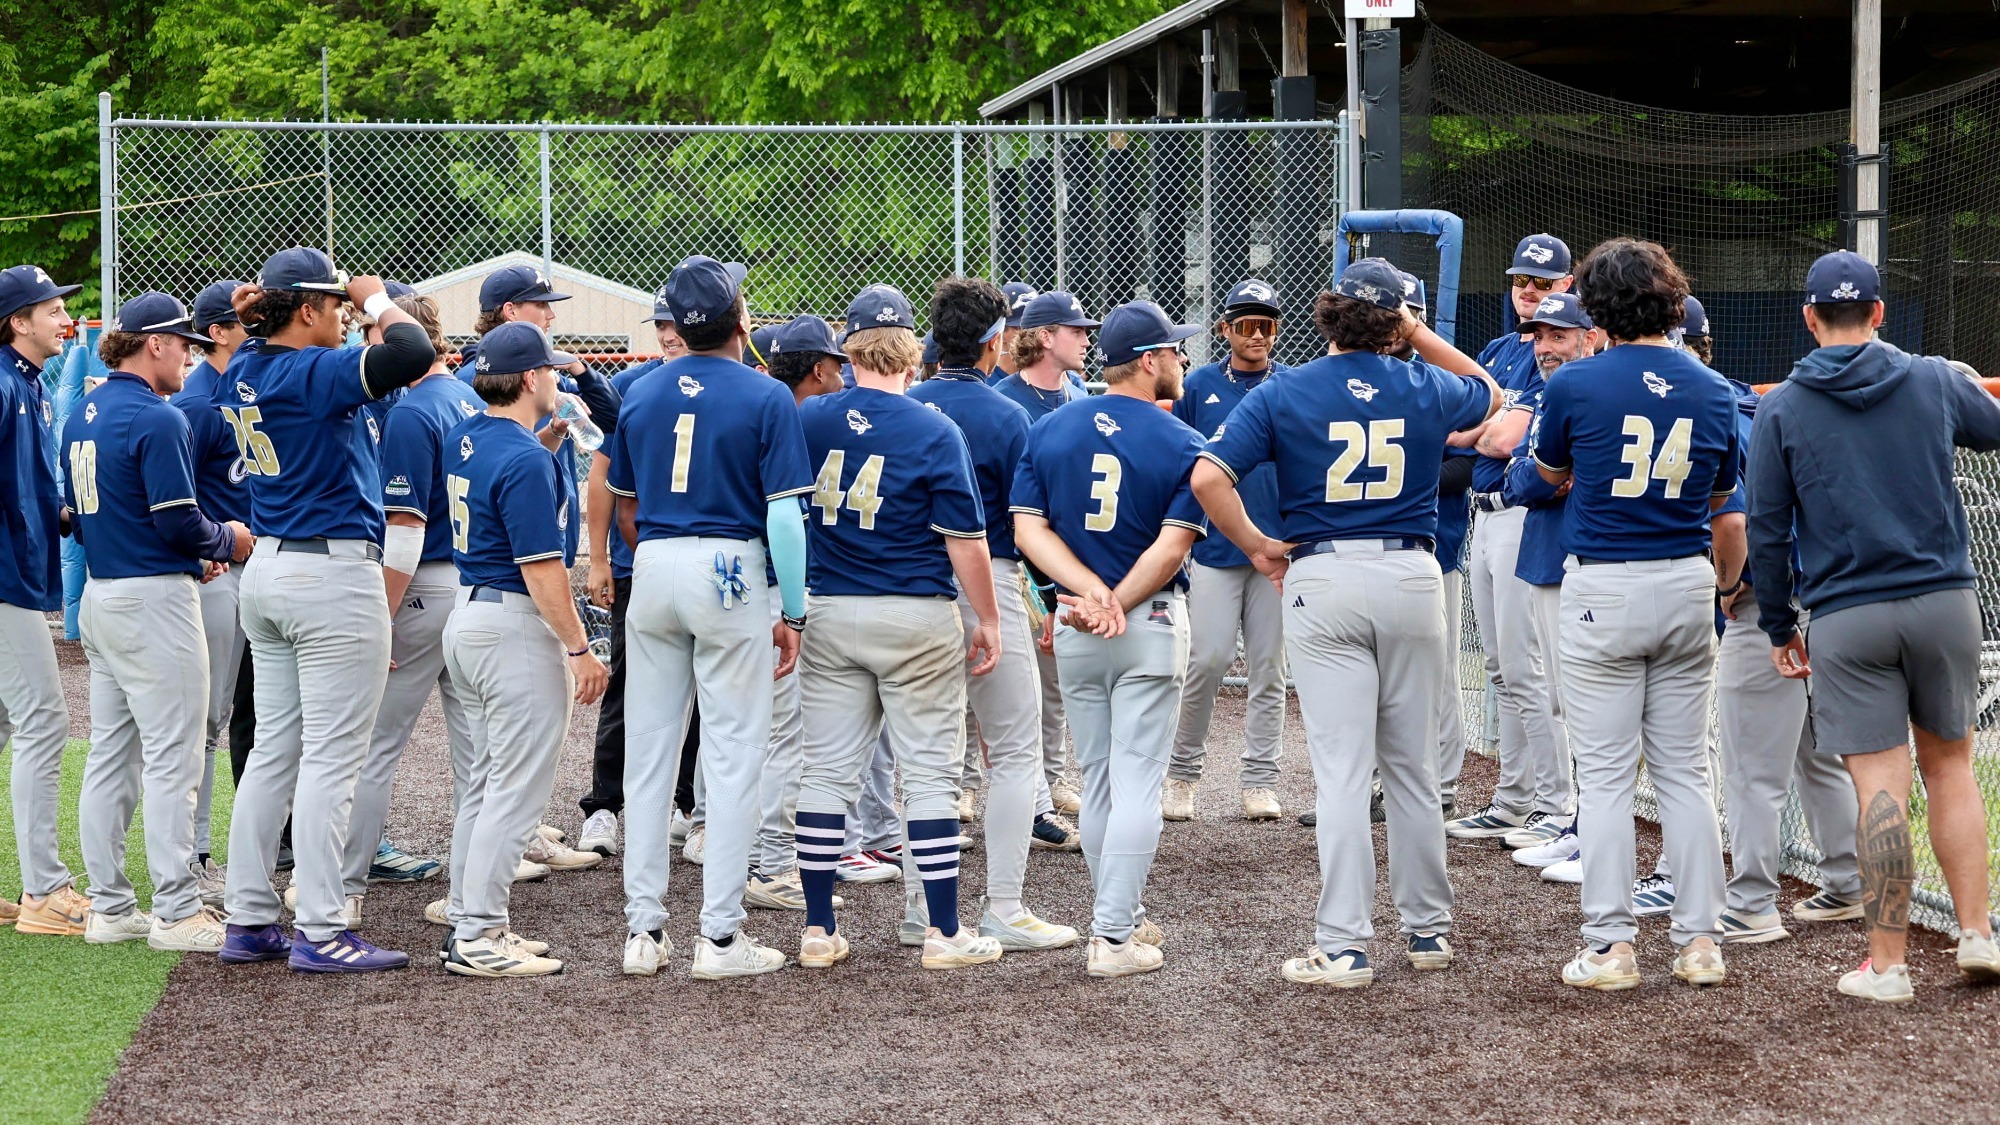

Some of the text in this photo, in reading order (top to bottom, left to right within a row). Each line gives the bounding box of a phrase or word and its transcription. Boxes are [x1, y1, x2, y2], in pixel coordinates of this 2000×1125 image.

[69, 440, 99, 515] 10
[220, 405, 280, 476] 26
[671, 413, 696, 493] 1
[1325, 418, 1406, 503] 25
[1611, 414, 1694, 499] 34
[811, 449, 885, 531] 44
[1085, 453, 1122, 532] 3
